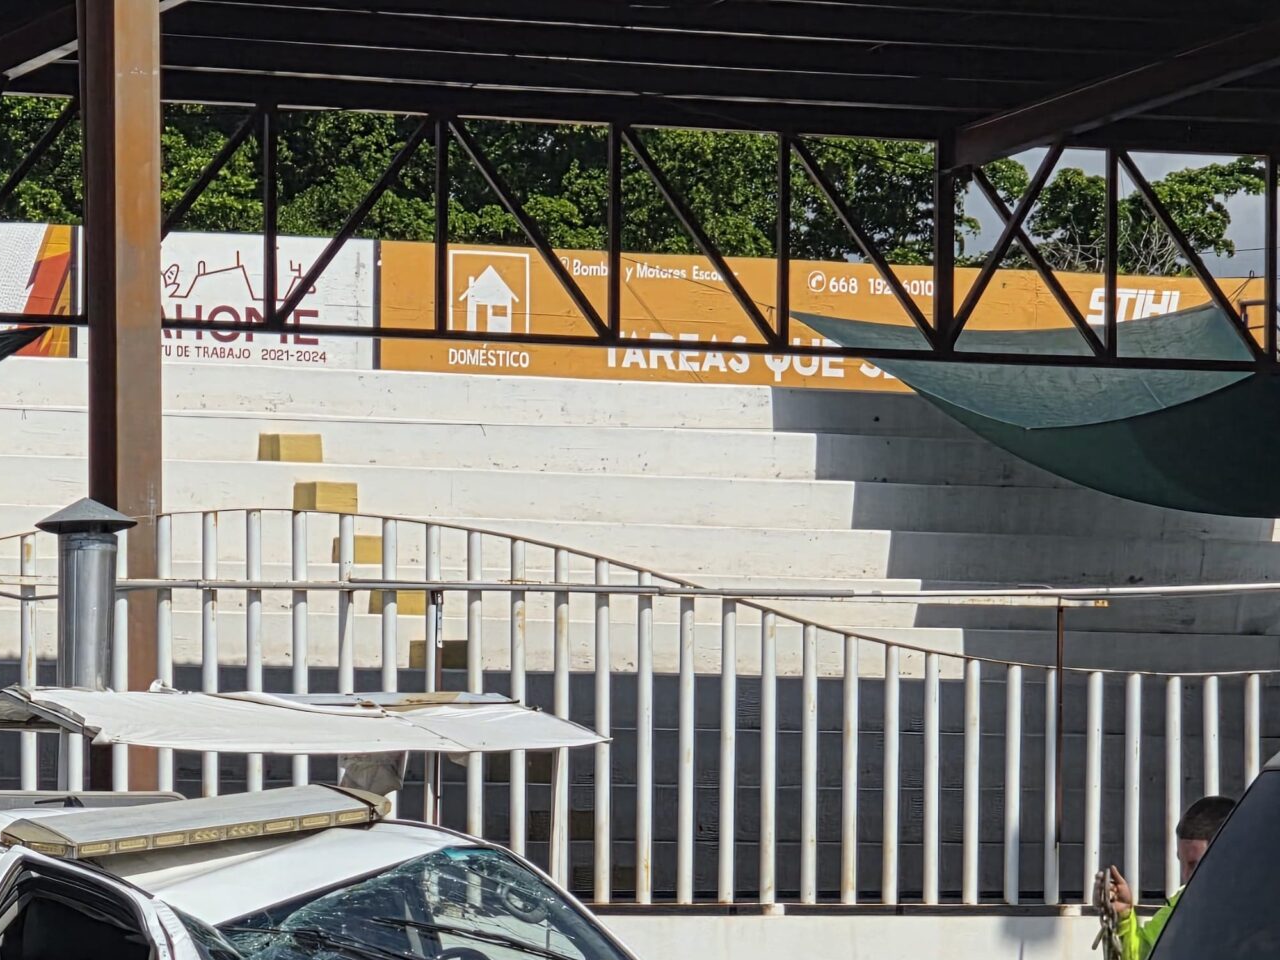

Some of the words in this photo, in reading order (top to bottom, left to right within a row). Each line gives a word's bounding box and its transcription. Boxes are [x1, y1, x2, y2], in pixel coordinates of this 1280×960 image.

[626, 266, 634, 283] y
[636, 262, 687, 279] Motores
[829, 276, 858, 294] 668
[176, 345, 190, 358] DE
[195, 346, 251, 359] TRABAJO
[261, 348, 327, 363] 2021-2024
[448, 344, 530, 368] DOMÉSTICO
[607, 331, 750, 374] TAREAS
[764, 337, 845, 382] QUE
